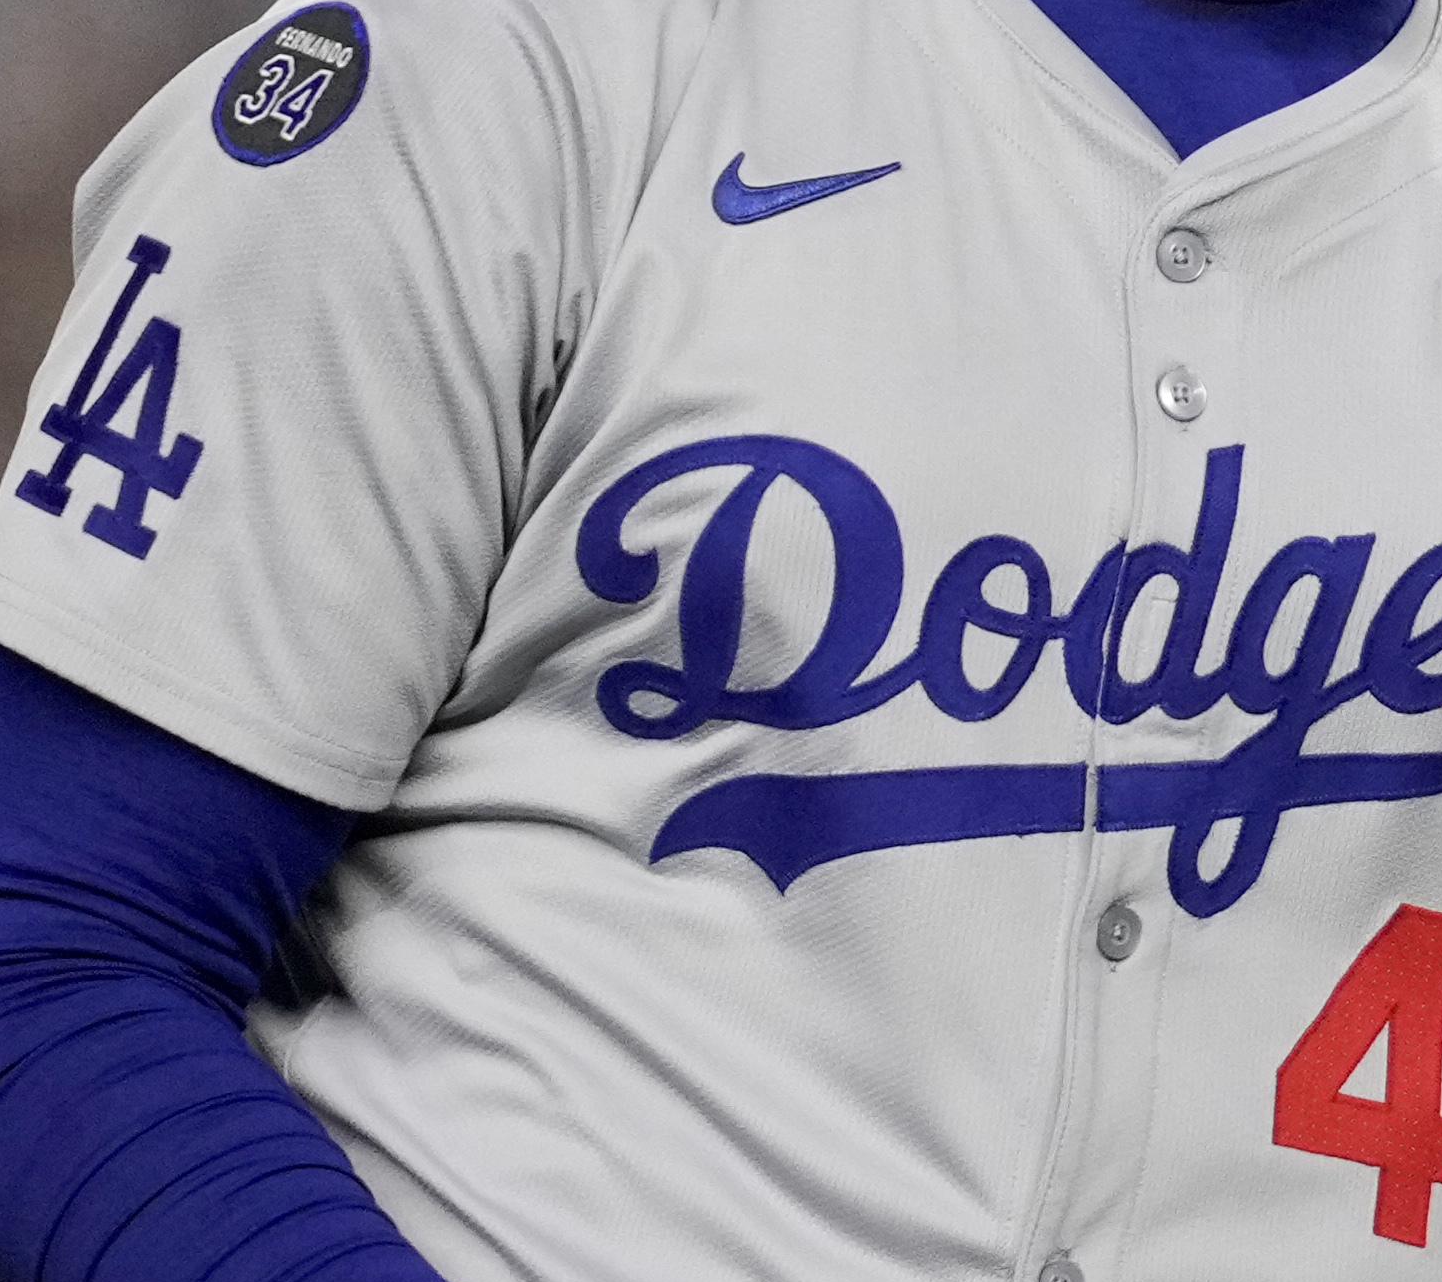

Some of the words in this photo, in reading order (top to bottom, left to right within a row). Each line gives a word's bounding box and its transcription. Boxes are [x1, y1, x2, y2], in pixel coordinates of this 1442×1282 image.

[275, 26, 354, 68] FERNANDO
[234, 53, 335, 141] 34
[15, 234, 204, 559] LA
